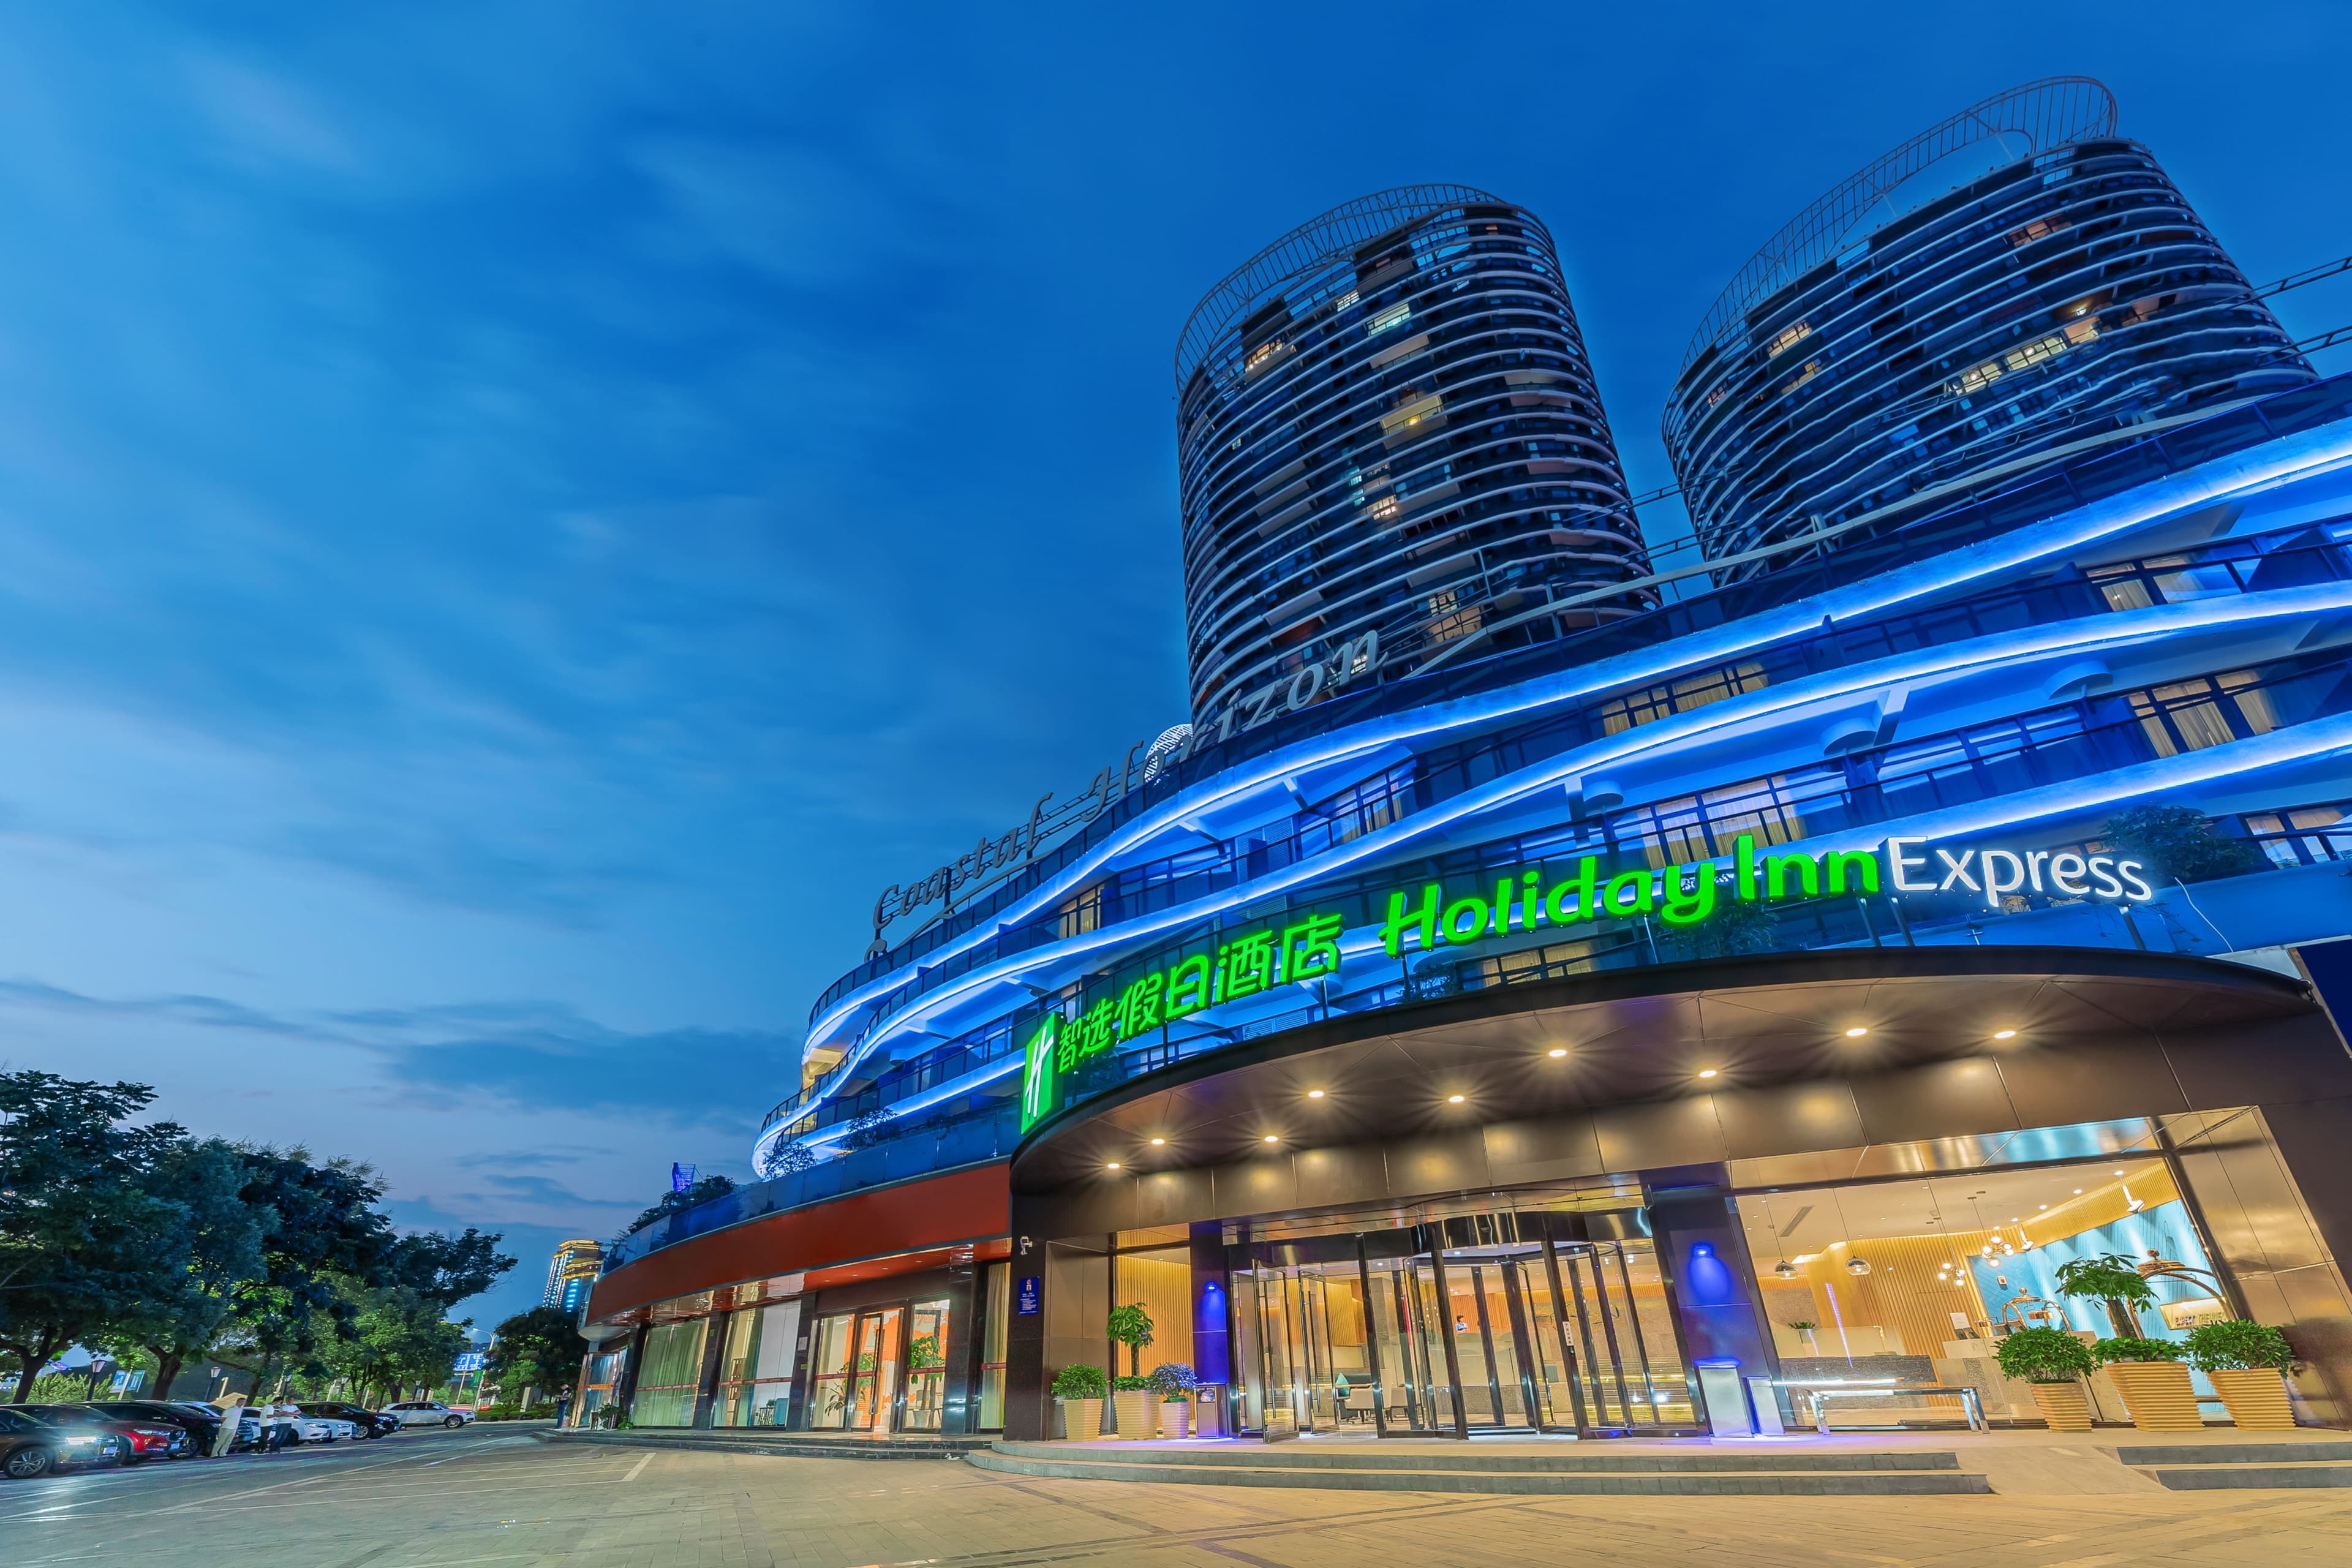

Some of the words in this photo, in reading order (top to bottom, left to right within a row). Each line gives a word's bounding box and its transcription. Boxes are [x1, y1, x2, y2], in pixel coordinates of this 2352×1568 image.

[872, 791, 1054, 929] Coastal
[1081, 630, 1389, 821] Horizon
[1377, 856, 1716, 956] Holiday
[1738, 834, 1879, 900] Inn
[1888, 836, 2152, 908] Express
[1057, 913, 1342, 1073] 智选假日酒店
